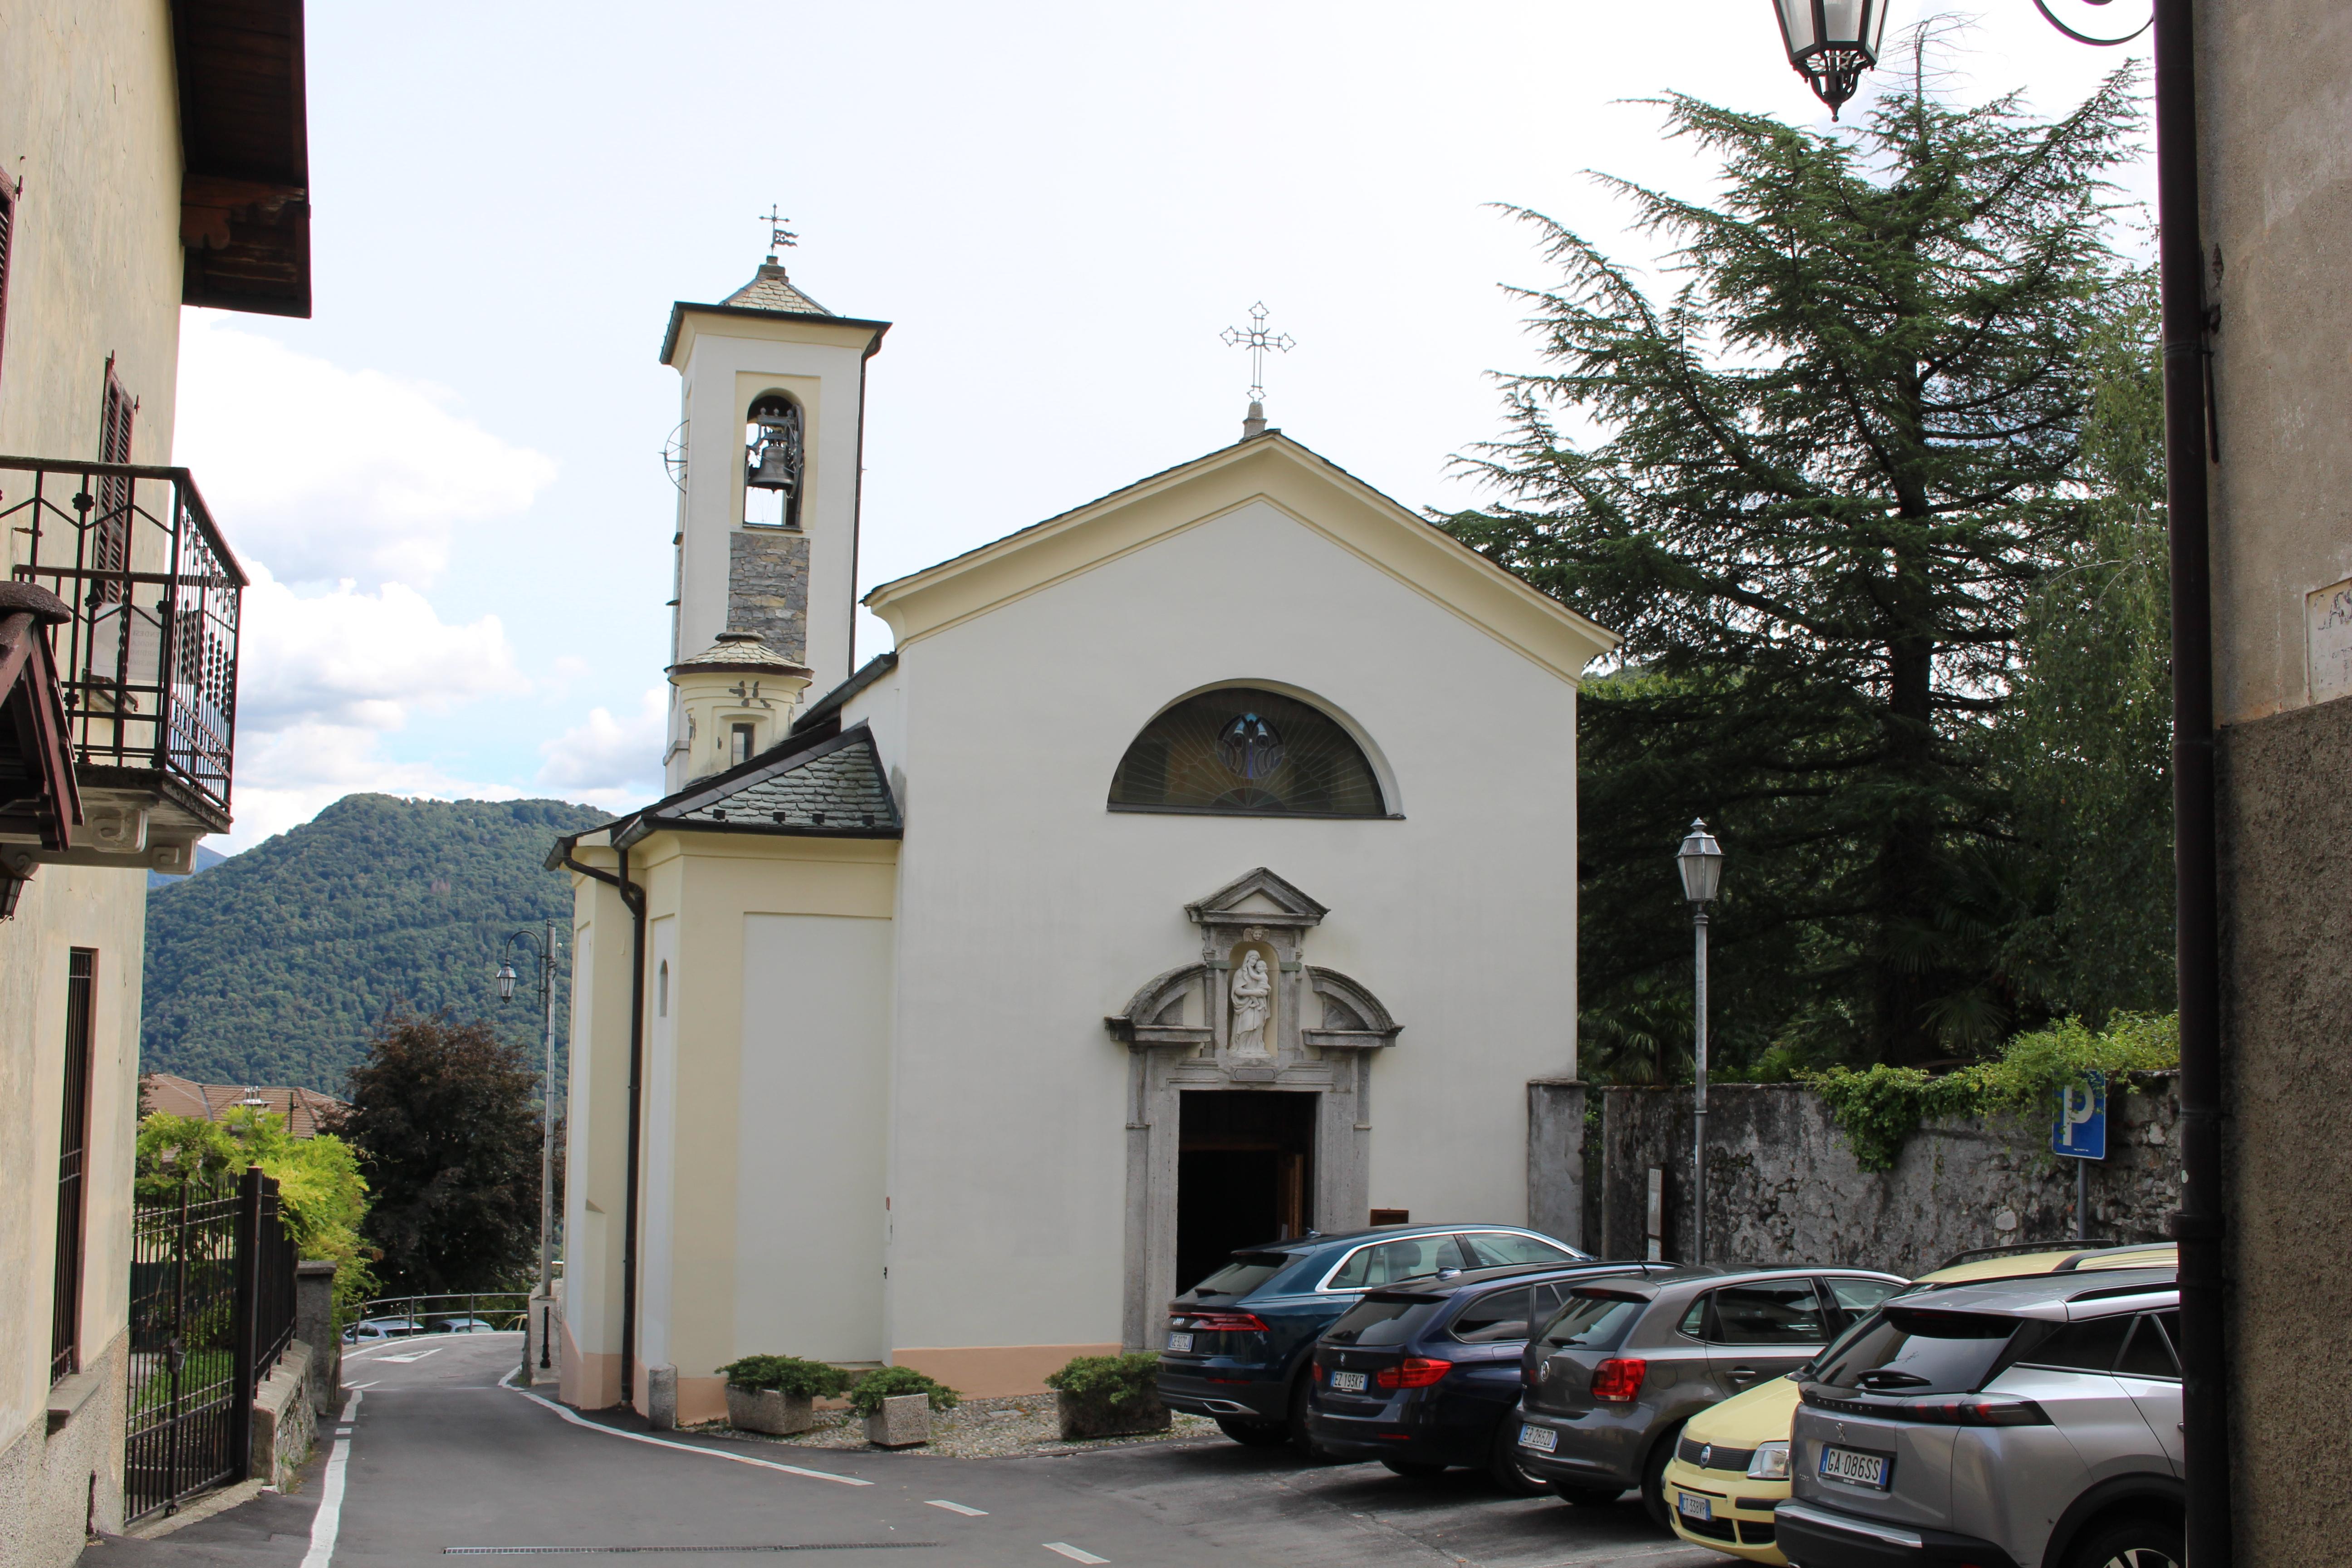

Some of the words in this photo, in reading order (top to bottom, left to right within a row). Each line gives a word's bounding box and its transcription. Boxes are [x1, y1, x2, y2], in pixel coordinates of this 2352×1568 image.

[2063, 1080, 2095, 1147] P
[1334, 1373, 1343, 1386] EZ
[1344, 1374, 1364, 1388] 193KF
[1524, 1426, 1534, 1441] ER
[1828, 1450, 1841, 1473] GA
[1844, 1454, 1880, 1481] 086SS
[1690, 1499, 1705, 1515] 338VP
